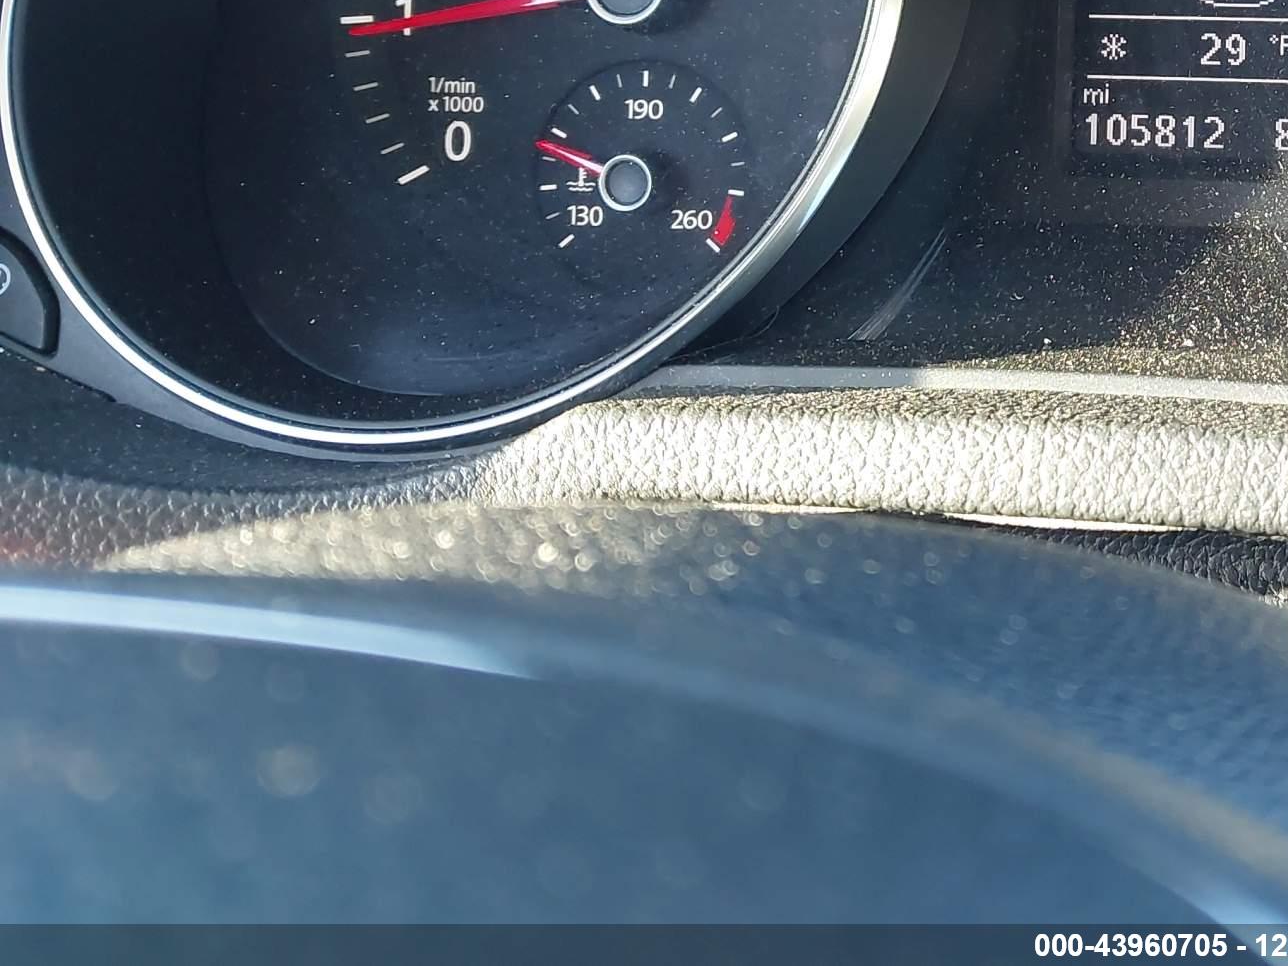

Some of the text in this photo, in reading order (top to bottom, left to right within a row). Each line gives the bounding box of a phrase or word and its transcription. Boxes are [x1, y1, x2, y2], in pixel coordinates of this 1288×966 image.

[1200, 33, 1246, 66] 29
[428, 77, 476, 95] 1/min
[1083, 83, 1110, 105] mi
[444, 96, 484, 114] 1000
[625, 99, 663, 120] 190
[445, 121, 471, 161] 0
[1085, 113, 1225, 148] 105812
[567, 206, 603, 228] 130
[671, 210, 713, 232] 260
